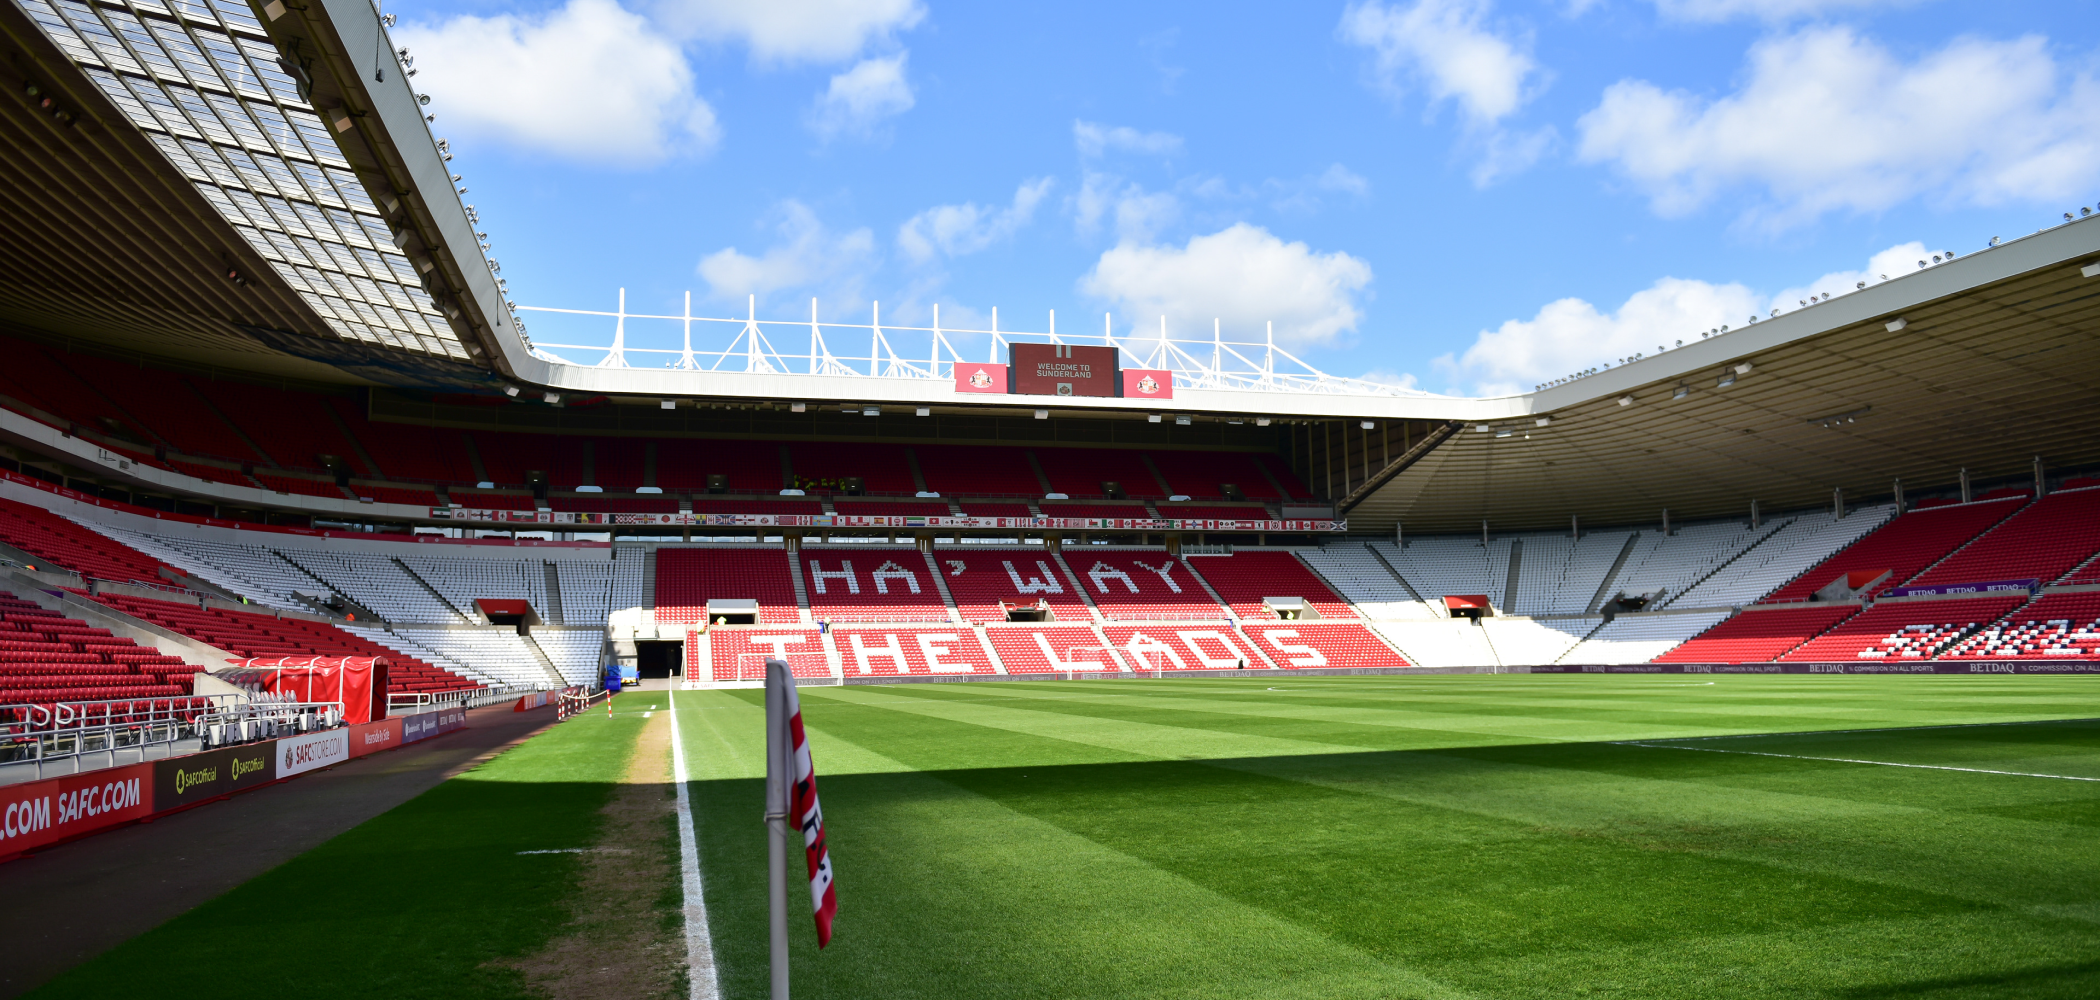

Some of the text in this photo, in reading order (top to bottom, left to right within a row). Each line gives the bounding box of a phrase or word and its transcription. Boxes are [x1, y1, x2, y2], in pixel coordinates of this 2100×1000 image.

[1037, 363, 1078, 371] WELCOME
[1036, 370, 1092, 378] SUNDERLAND
[750, 629, 1328, 676] THE LADS
[1350, 668, 1382, 676] BETDAQ
[1582, 665, 1606, 673] BETDAQ
[1683, 665, 1711, 673] BETDAQ
[1809, 664, 1844, 673] BETDAQ
[1970, 663, 2015, 674] BETDAQ
[296, 737, 343, 765] SAFCSTORE.COM
[239, 756, 265, 775] SAFCOfficial
[185, 766, 217, 787] SAFCOfficial
[58, 778, 140, 825] SAFC.COM
